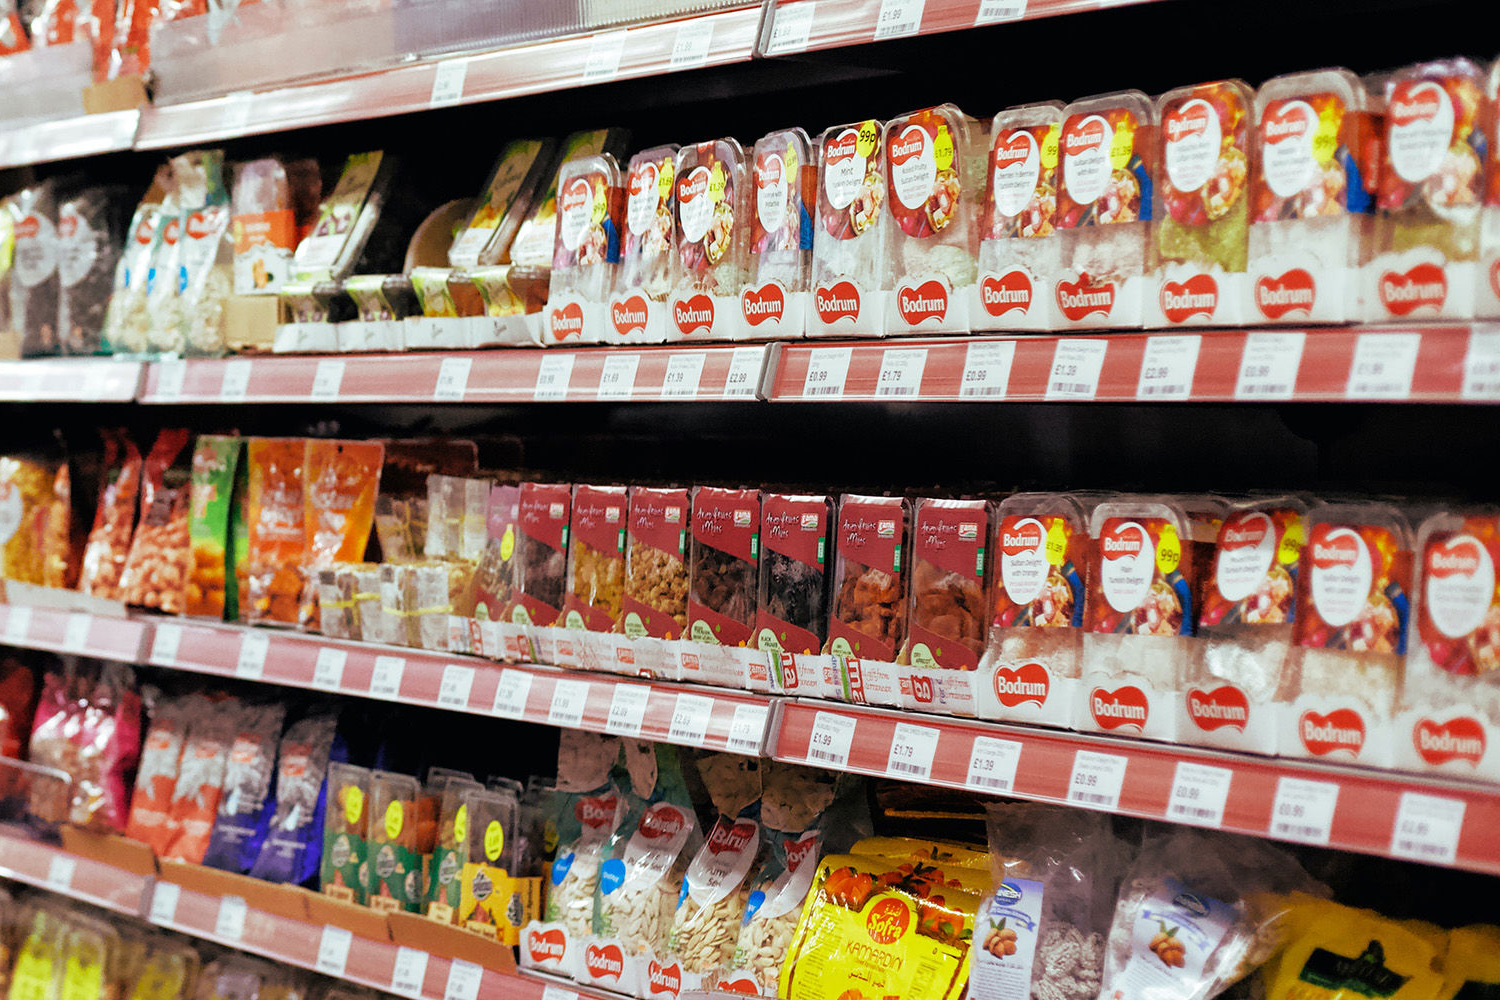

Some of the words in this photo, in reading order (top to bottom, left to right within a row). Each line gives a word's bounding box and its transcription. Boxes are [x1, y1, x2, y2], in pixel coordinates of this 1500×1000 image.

[859, 130, 875, 145] 99p
[1067, 130, 1102, 147] Bodrum
[827, 142, 855, 158] Bodrum
[892, 141, 922, 158] Bodrum
[997, 145, 1028, 160] Bodrum
[1047, 145, 1058, 155] 99
[984, 285, 1029, 304] Bodrum
[1060, 287, 1111, 308] Bodrum
[1260, 284, 1312, 305] Bodrum
[1384, 279, 1444, 302] Bodrum
[745, 296, 781, 316] Bodrum
[818, 295, 857, 313] Bodrum
[902, 295, 945, 313] Bodrum
[1165, 289, 1215, 310] Bodrum
[614, 307, 646, 325] Bodrum
[676, 306, 712, 324] Bodrum
[729, 372, 747, 383] £2.99
[809, 370, 827, 382] £0.99
[881, 370, 901, 382] £1.79
[966, 369, 987, 382] £0.99
[1003, 533, 1039, 547] Bodrum
[1104, 537, 1140, 551] Bodrum
[1160, 549, 1179, 564] 99p
[998, 676, 1046, 696] Bodrum
[1094, 697, 1145, 719] Bodrum
[1191, 697, 1245, 720] Bodrum
[813, 732, 832, 746] £1.99
[1304, 720, 1361, 744] Bodrum
[893, 744, 914, 757] £1.79
[1420, 731, 1481, 754] Bodrum
[973, 757, 995, 771] £1.39
[1075, 772, 1098, 786] £0.99
[1175, 786, 1200, 800] £0.99
[868, 912, 902, 939] Sofra
[530, 936, 564, 956] Bodrum
[589, 951, 621, 973] Bodrum
